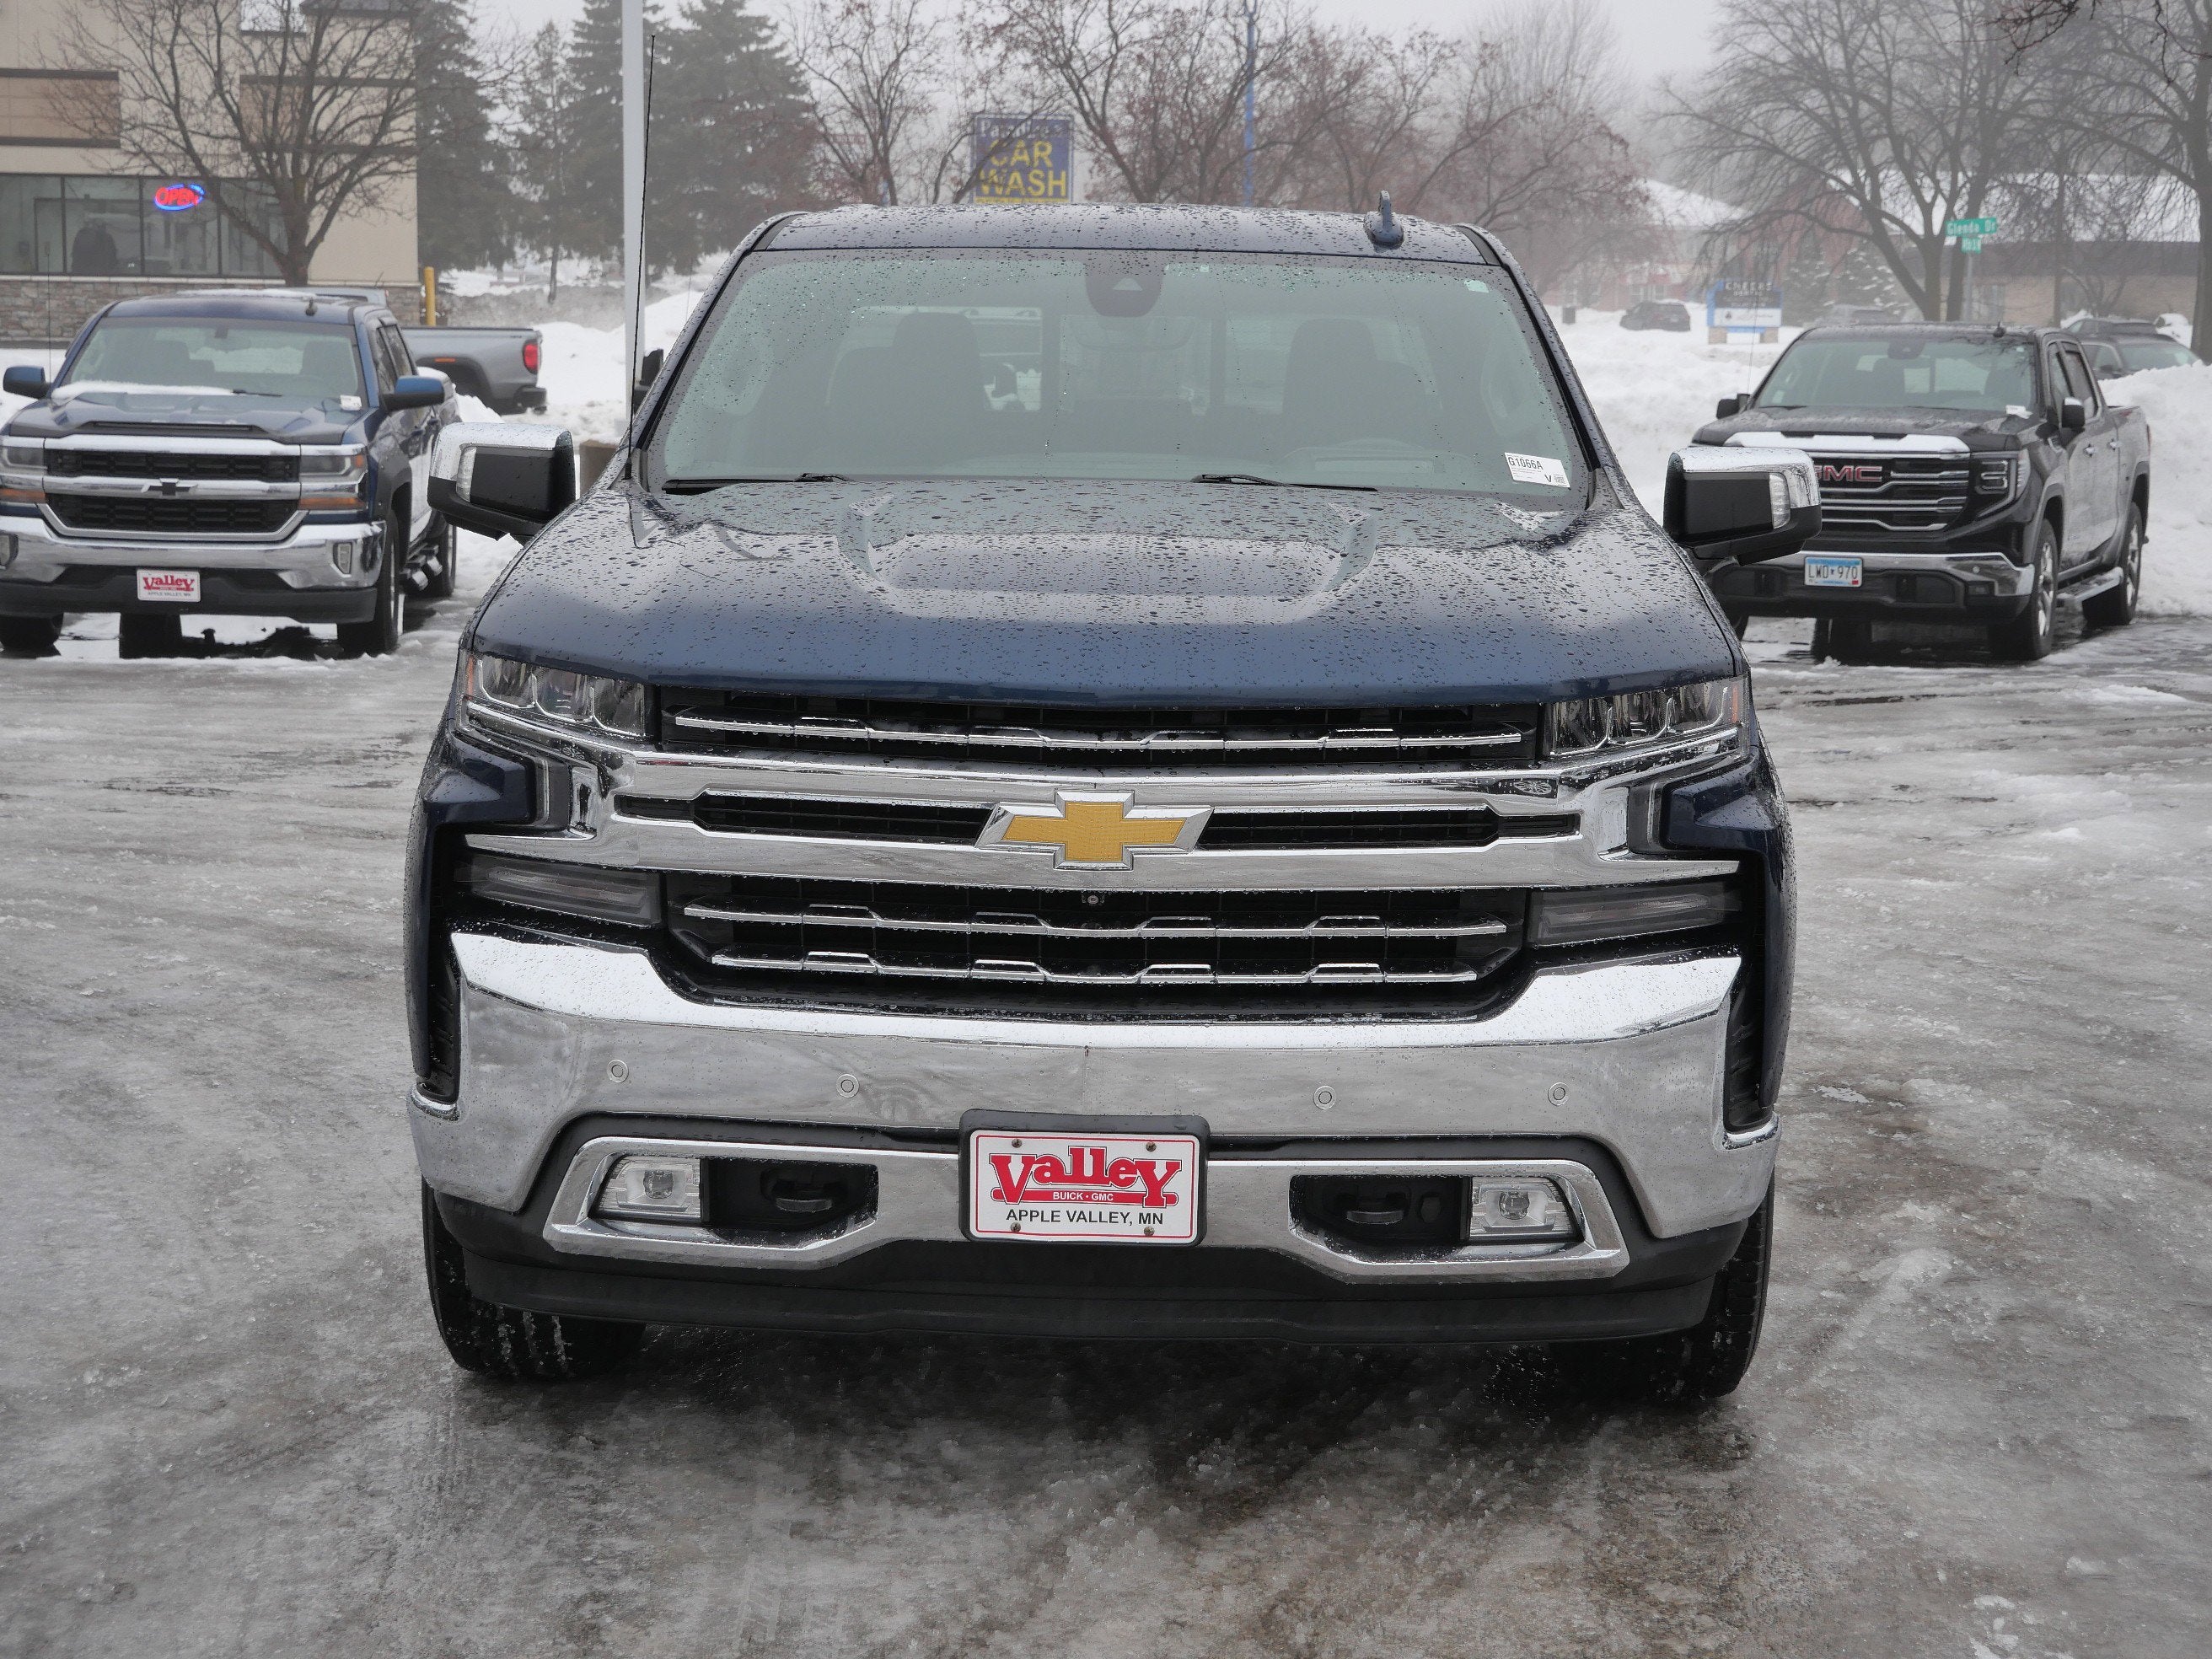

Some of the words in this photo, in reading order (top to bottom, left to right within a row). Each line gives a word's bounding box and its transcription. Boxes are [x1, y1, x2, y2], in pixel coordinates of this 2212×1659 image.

[990, 139, 1053, 167] CAR
[979, 169, 1067, 196] WASH
[155, 187, 199, 206] OPEN
[1508, 457, 1544, 470] G1066A
[1813, 464, 1883, 482] MC
[1052, 1191, 1084, 1200] BUICK
[1091, 1193, 1114, 1202] GMC
[1006, 1208, 1061, 1222] APPLE
[1066, 1210, 1134, 1226] VALLEY,
[1138, 1212, 1163, 1225] MN
